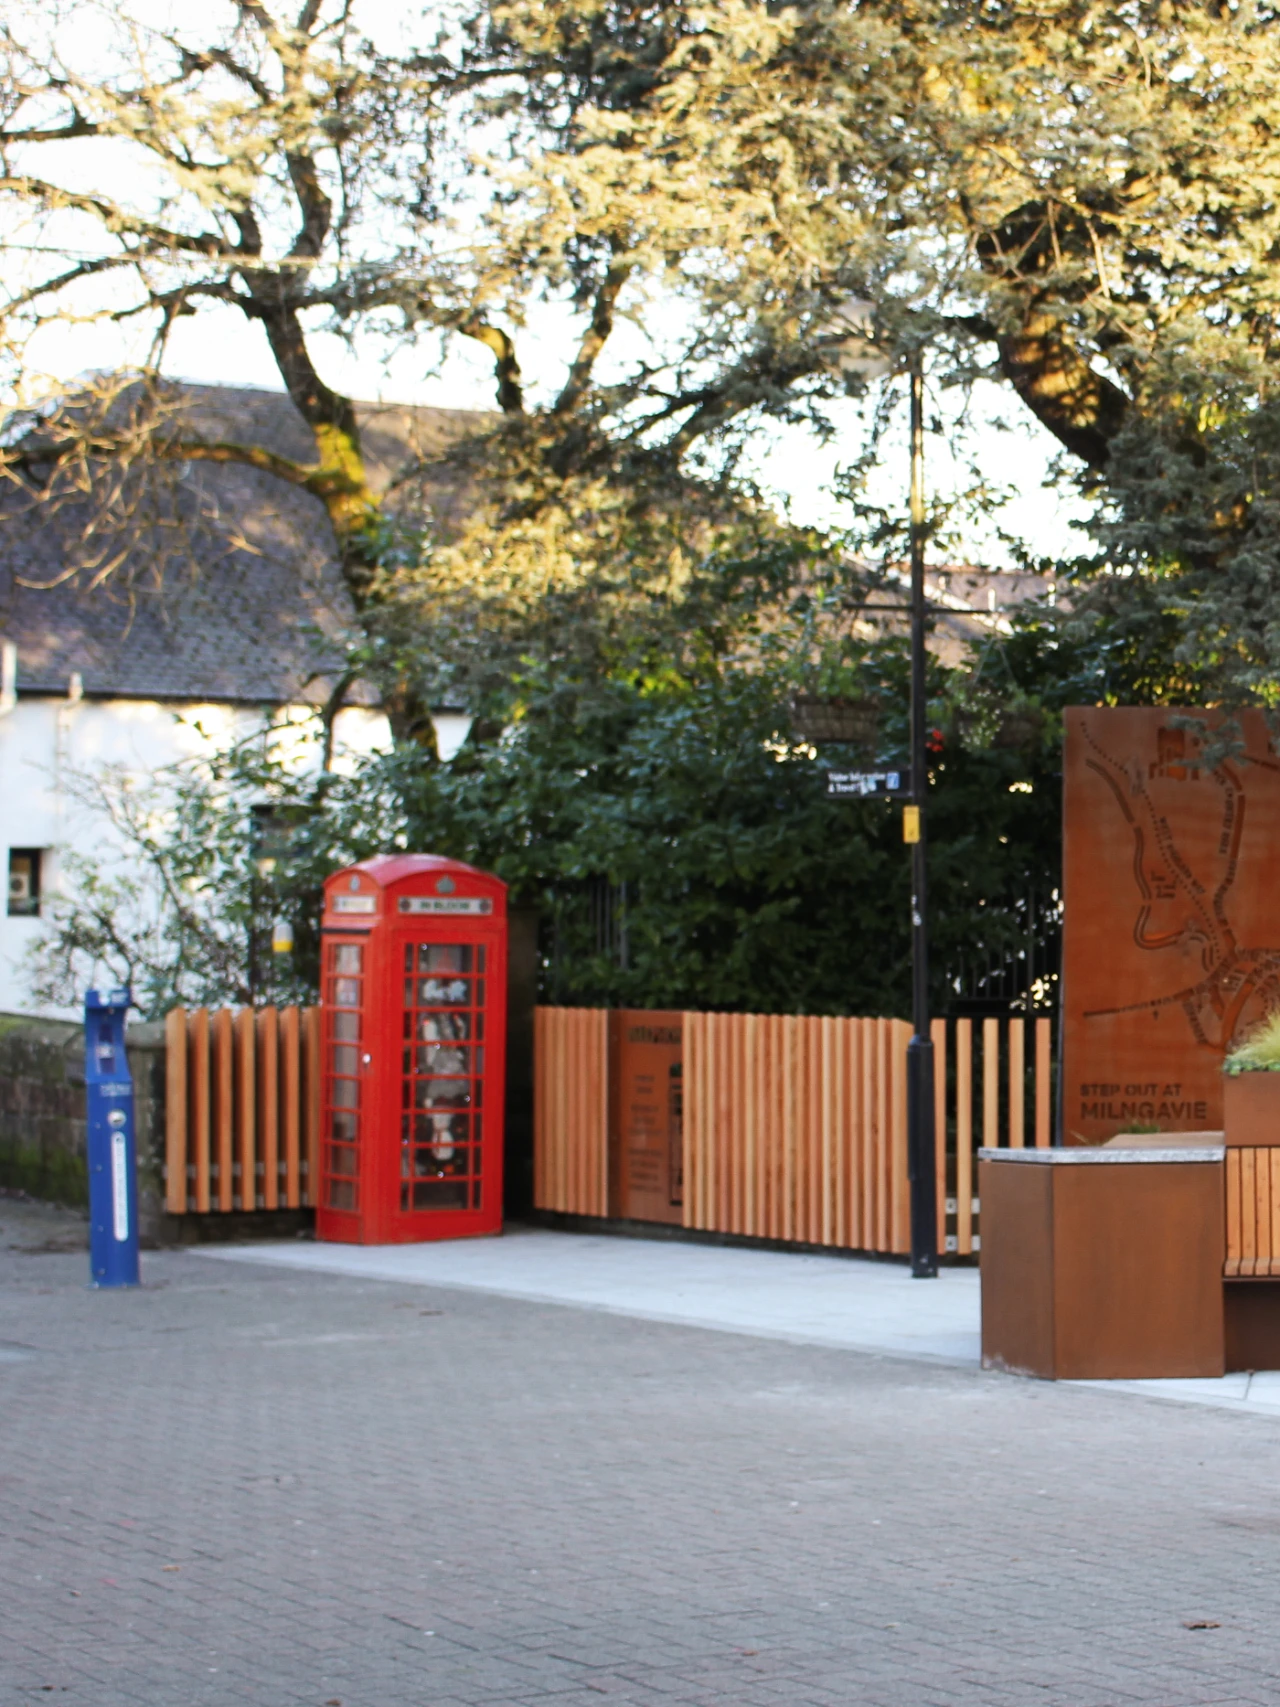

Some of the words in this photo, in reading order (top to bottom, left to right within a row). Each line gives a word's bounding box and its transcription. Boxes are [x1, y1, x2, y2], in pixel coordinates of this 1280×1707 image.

[1081, 1084, 1120, 1097] STEP
[1125, 1084, 1158, 1097] OUT
[1163, 1084, 1182, 1097] AT
[1081, 1102, 1207, 1120] MILNGAVIE
